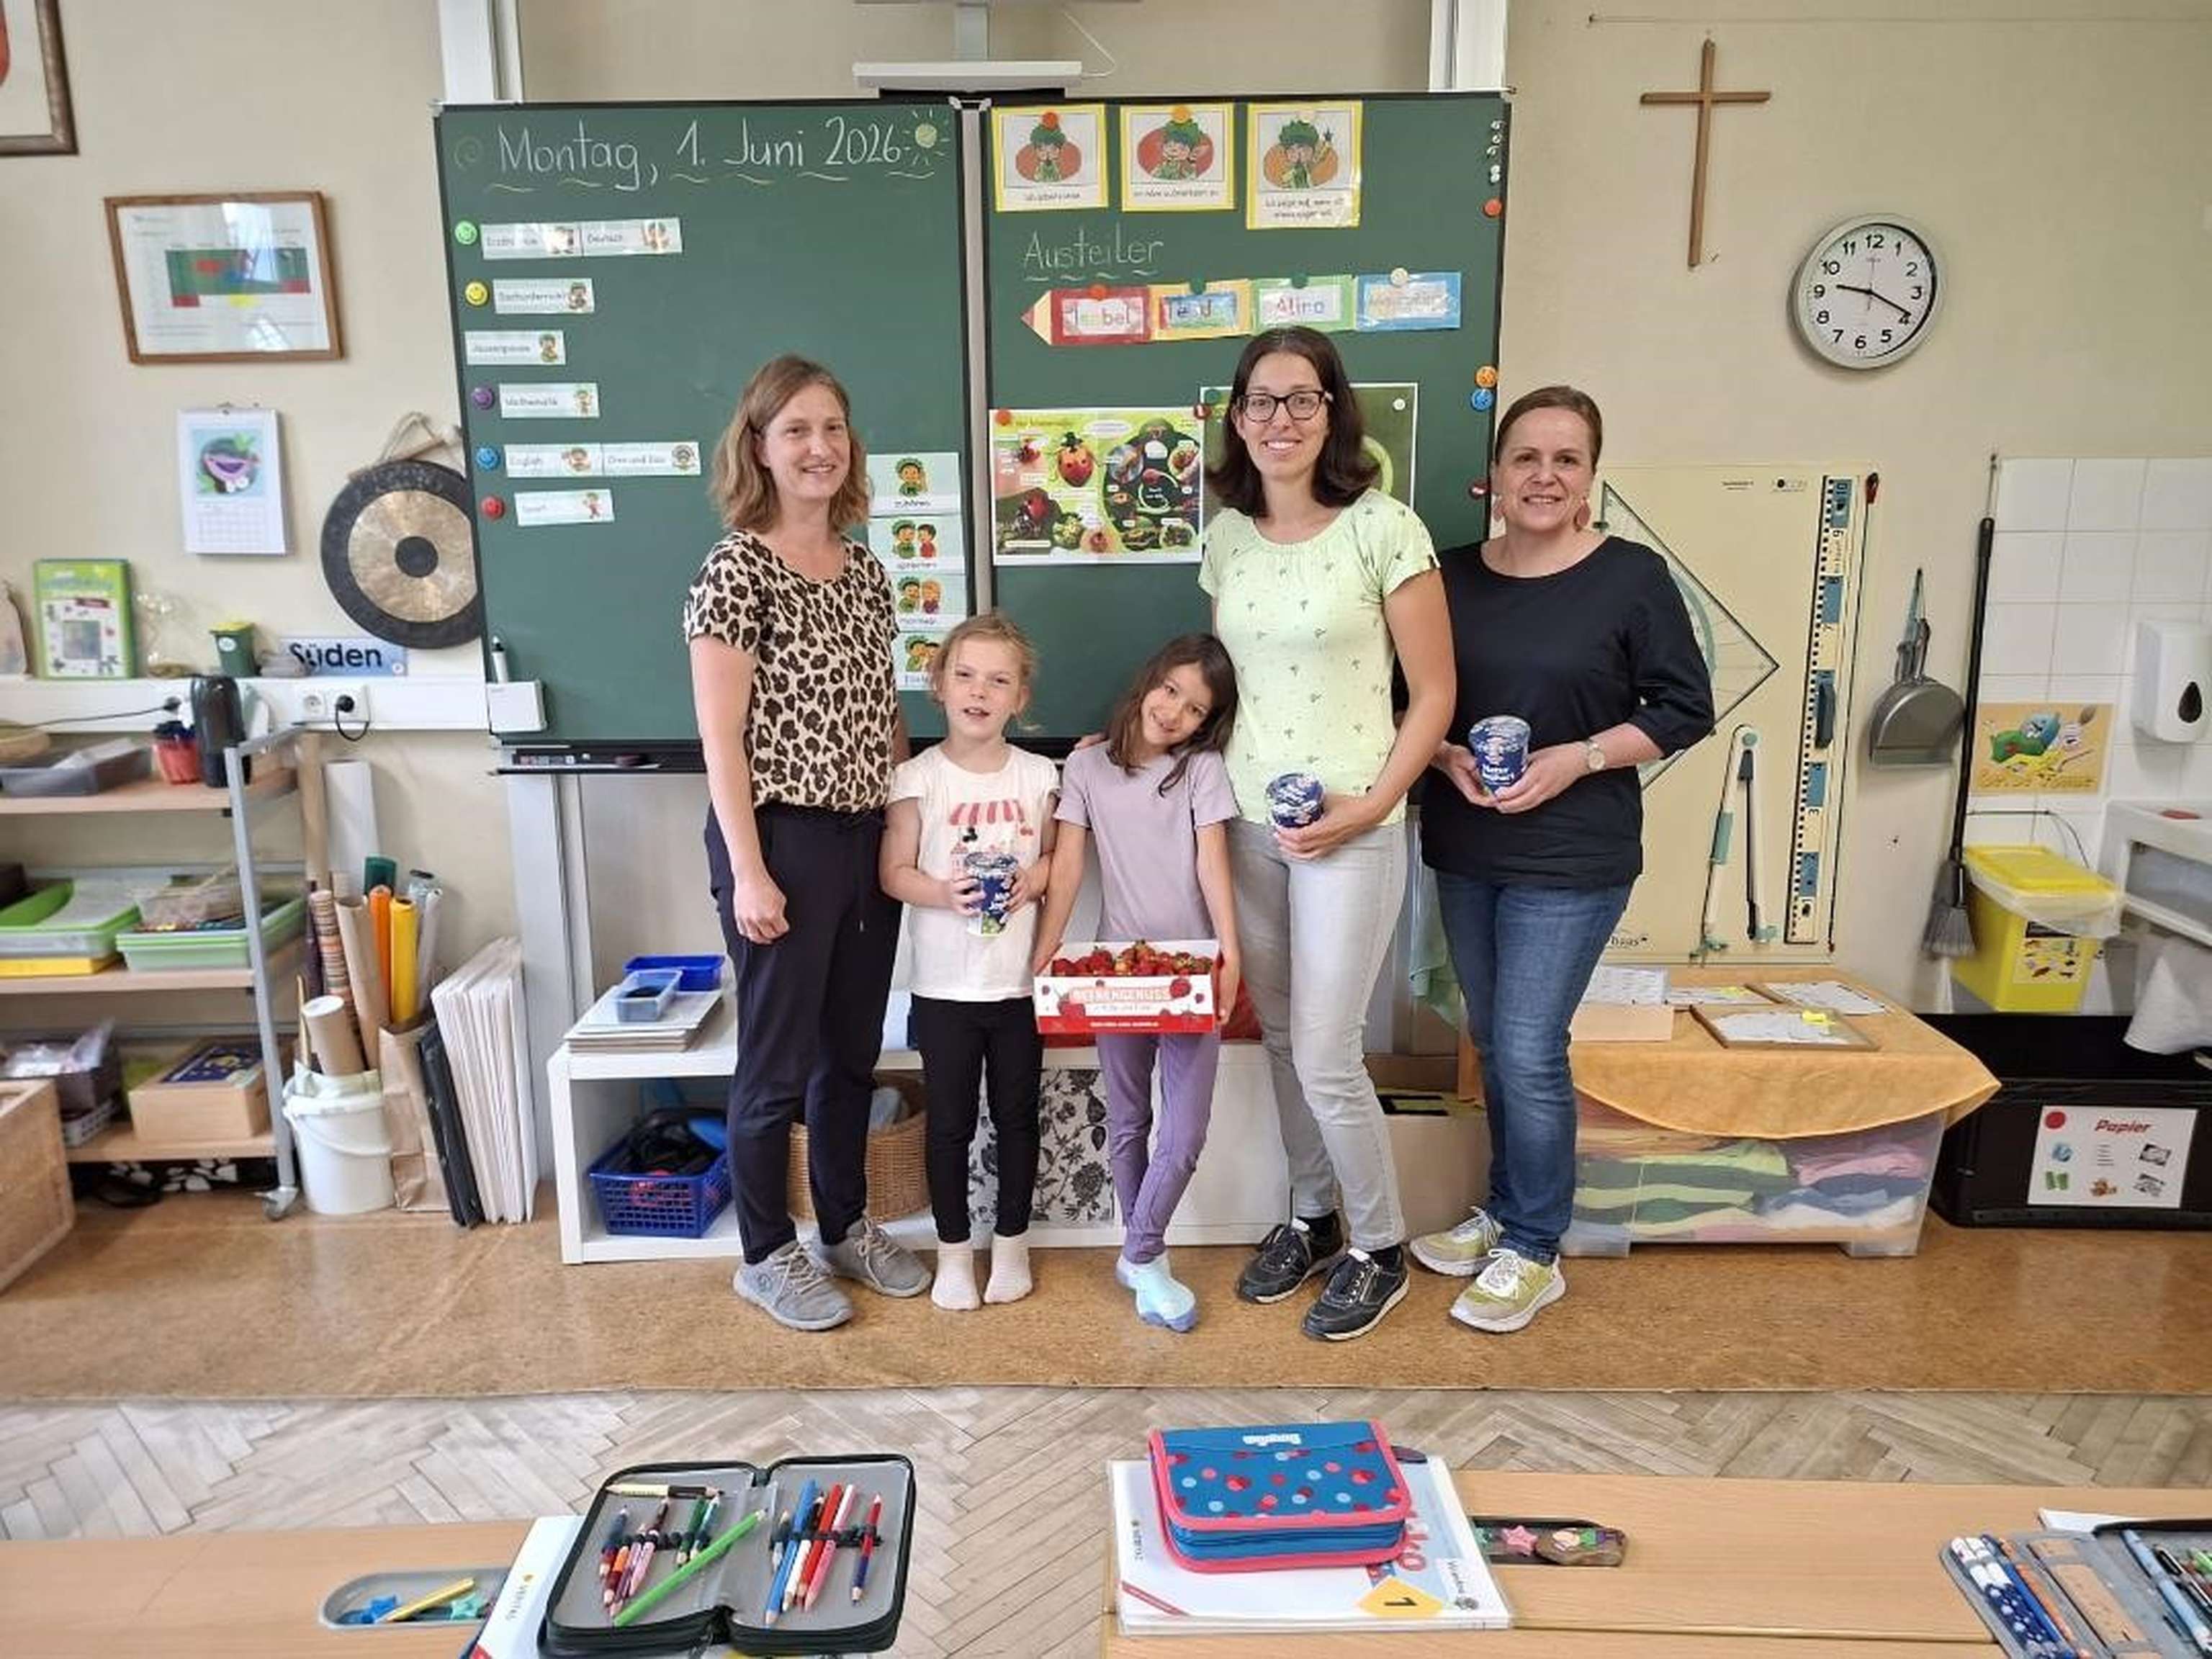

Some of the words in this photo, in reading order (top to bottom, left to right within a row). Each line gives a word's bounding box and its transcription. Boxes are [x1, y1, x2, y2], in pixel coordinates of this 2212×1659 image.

[498, 117, 658, 191] Montag,
[676, 120, 706, 166] 1.
[723, 117, 804, 166] Juni
[824, 115, 902, 166] 2026
[1022, 221, 1164, 271] Austeiler
[1843, 241, 1856, 256] 11
[1865, 234, 1884, 249] 12
[1894, 241, 1902, 256] 1
[1821, 261, 1840, 276] 10
[1905, 261, 1918, 277] 2
[1813, 284, 1826, 299] 9
[1910, 286, 1923, 300] 3
[1816, 310, 1830, 325] 8
[1833, 328, 1844, 343] 7
[1854, 335, 1867, 349] 6
[1880, 329, 1893, 343] 5
[289, 643, 382, 667] Süden
[2095, 1118, 2152, 1134] Papier
